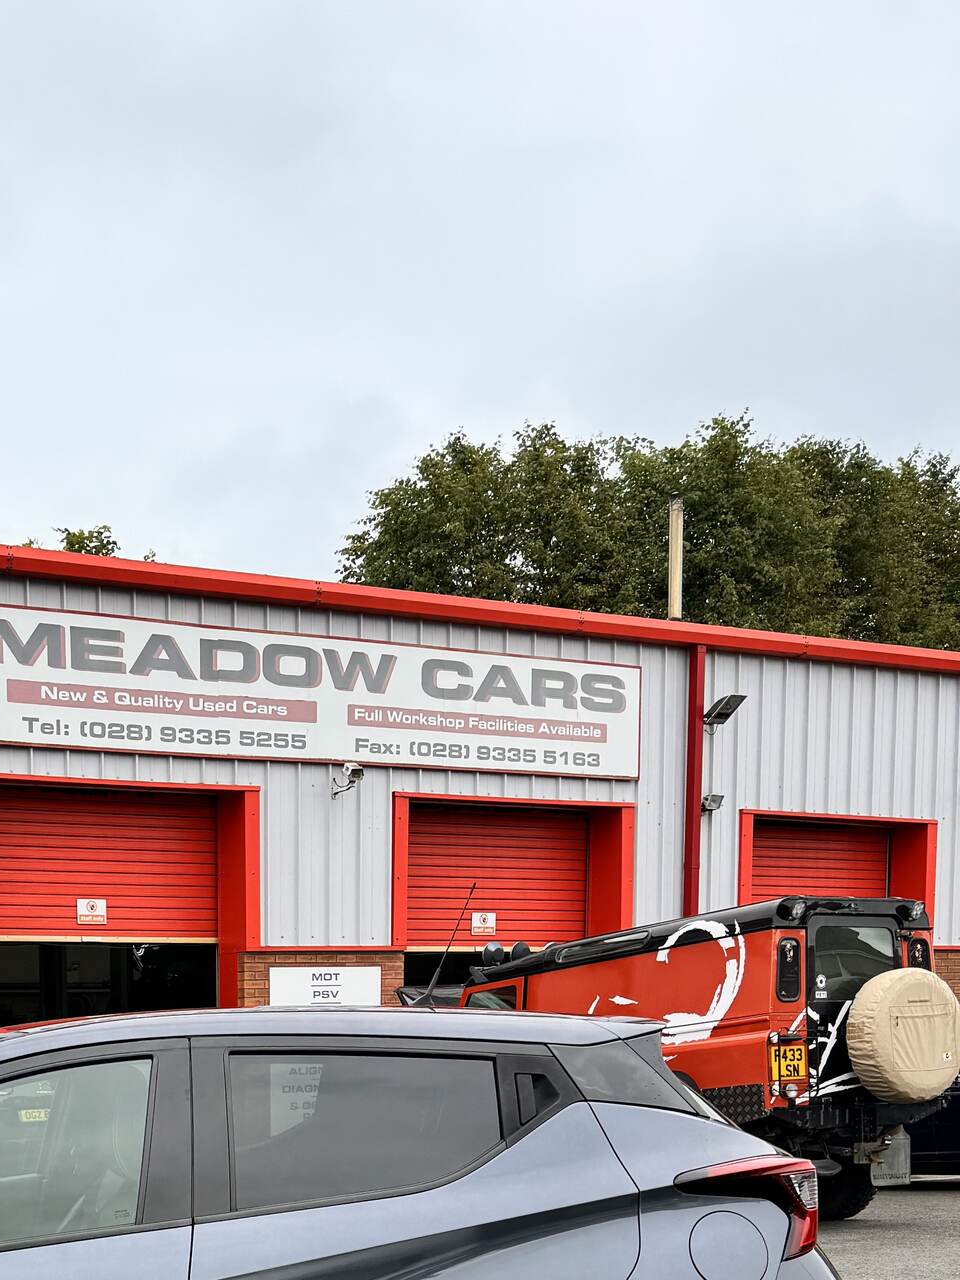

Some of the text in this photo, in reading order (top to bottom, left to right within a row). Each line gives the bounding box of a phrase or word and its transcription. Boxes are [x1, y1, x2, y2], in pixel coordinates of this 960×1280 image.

[421, 658, 627, 713] CARS
[40, 685, 288, 716] New & Quality Used Cars
[21, 716, 307, 750] Tel: (028) 9335 5255
[354, 708, 601, 737] Full Workshop Facilities Available
[354, 738, 601, 767] Fax: (028) 9335 5163
[311, 973, 340, 981] MOT
[313, 990, 339, 999] PSV
